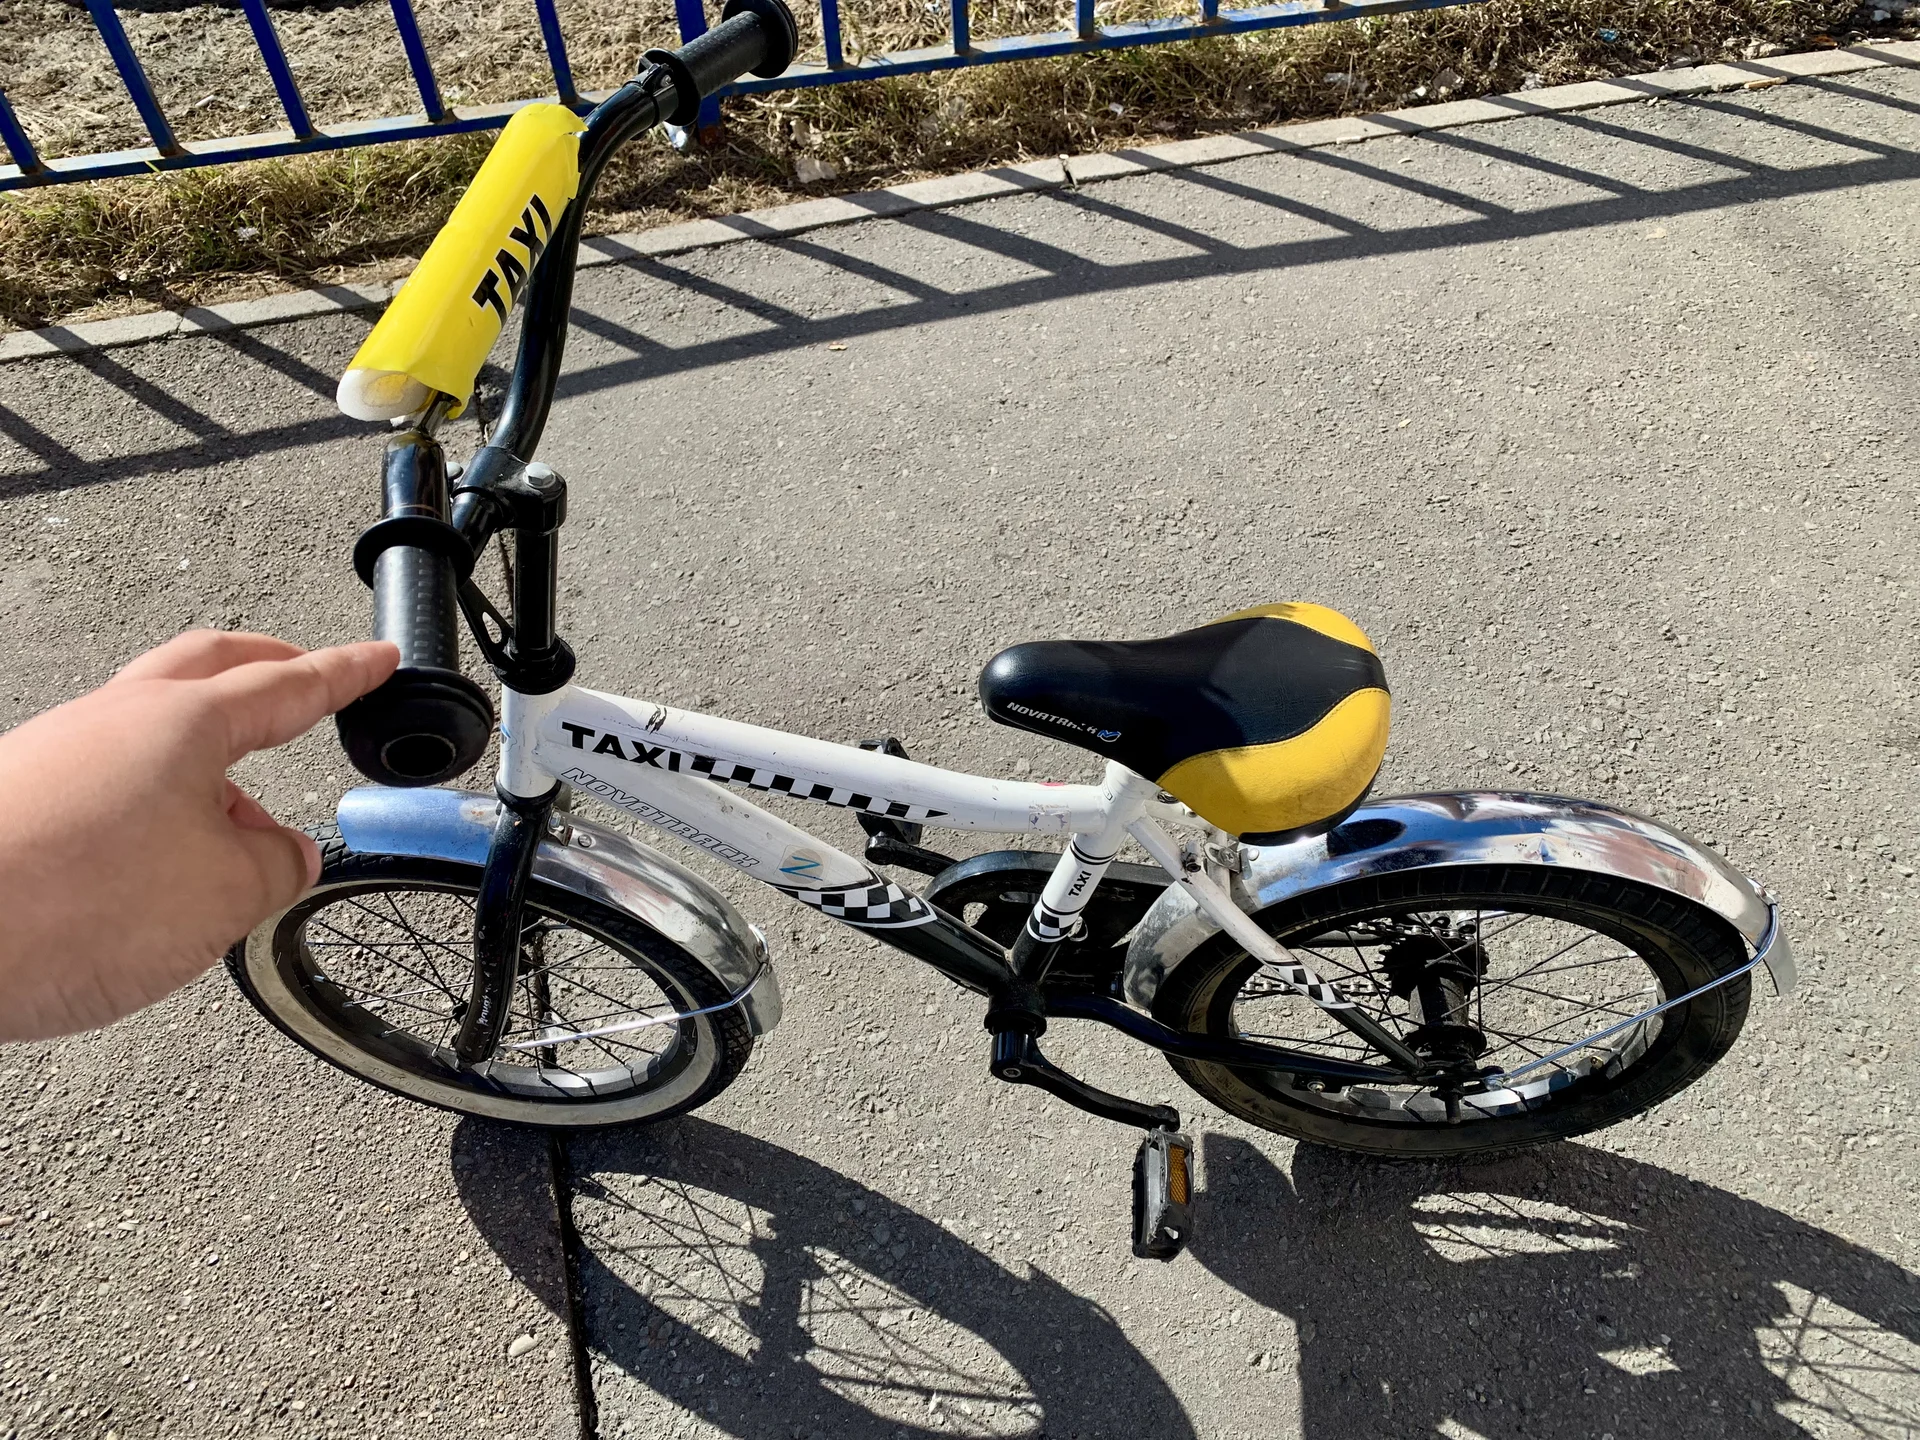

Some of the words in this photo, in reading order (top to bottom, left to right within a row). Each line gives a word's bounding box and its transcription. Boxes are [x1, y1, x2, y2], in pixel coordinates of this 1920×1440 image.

[471, 193, 553, 325] TAXI
[561, 721, 682, 772] TAXI
[561, 767, 763, 868] NOVATRACK
[1068, 870, 1092, 897] TAXI
